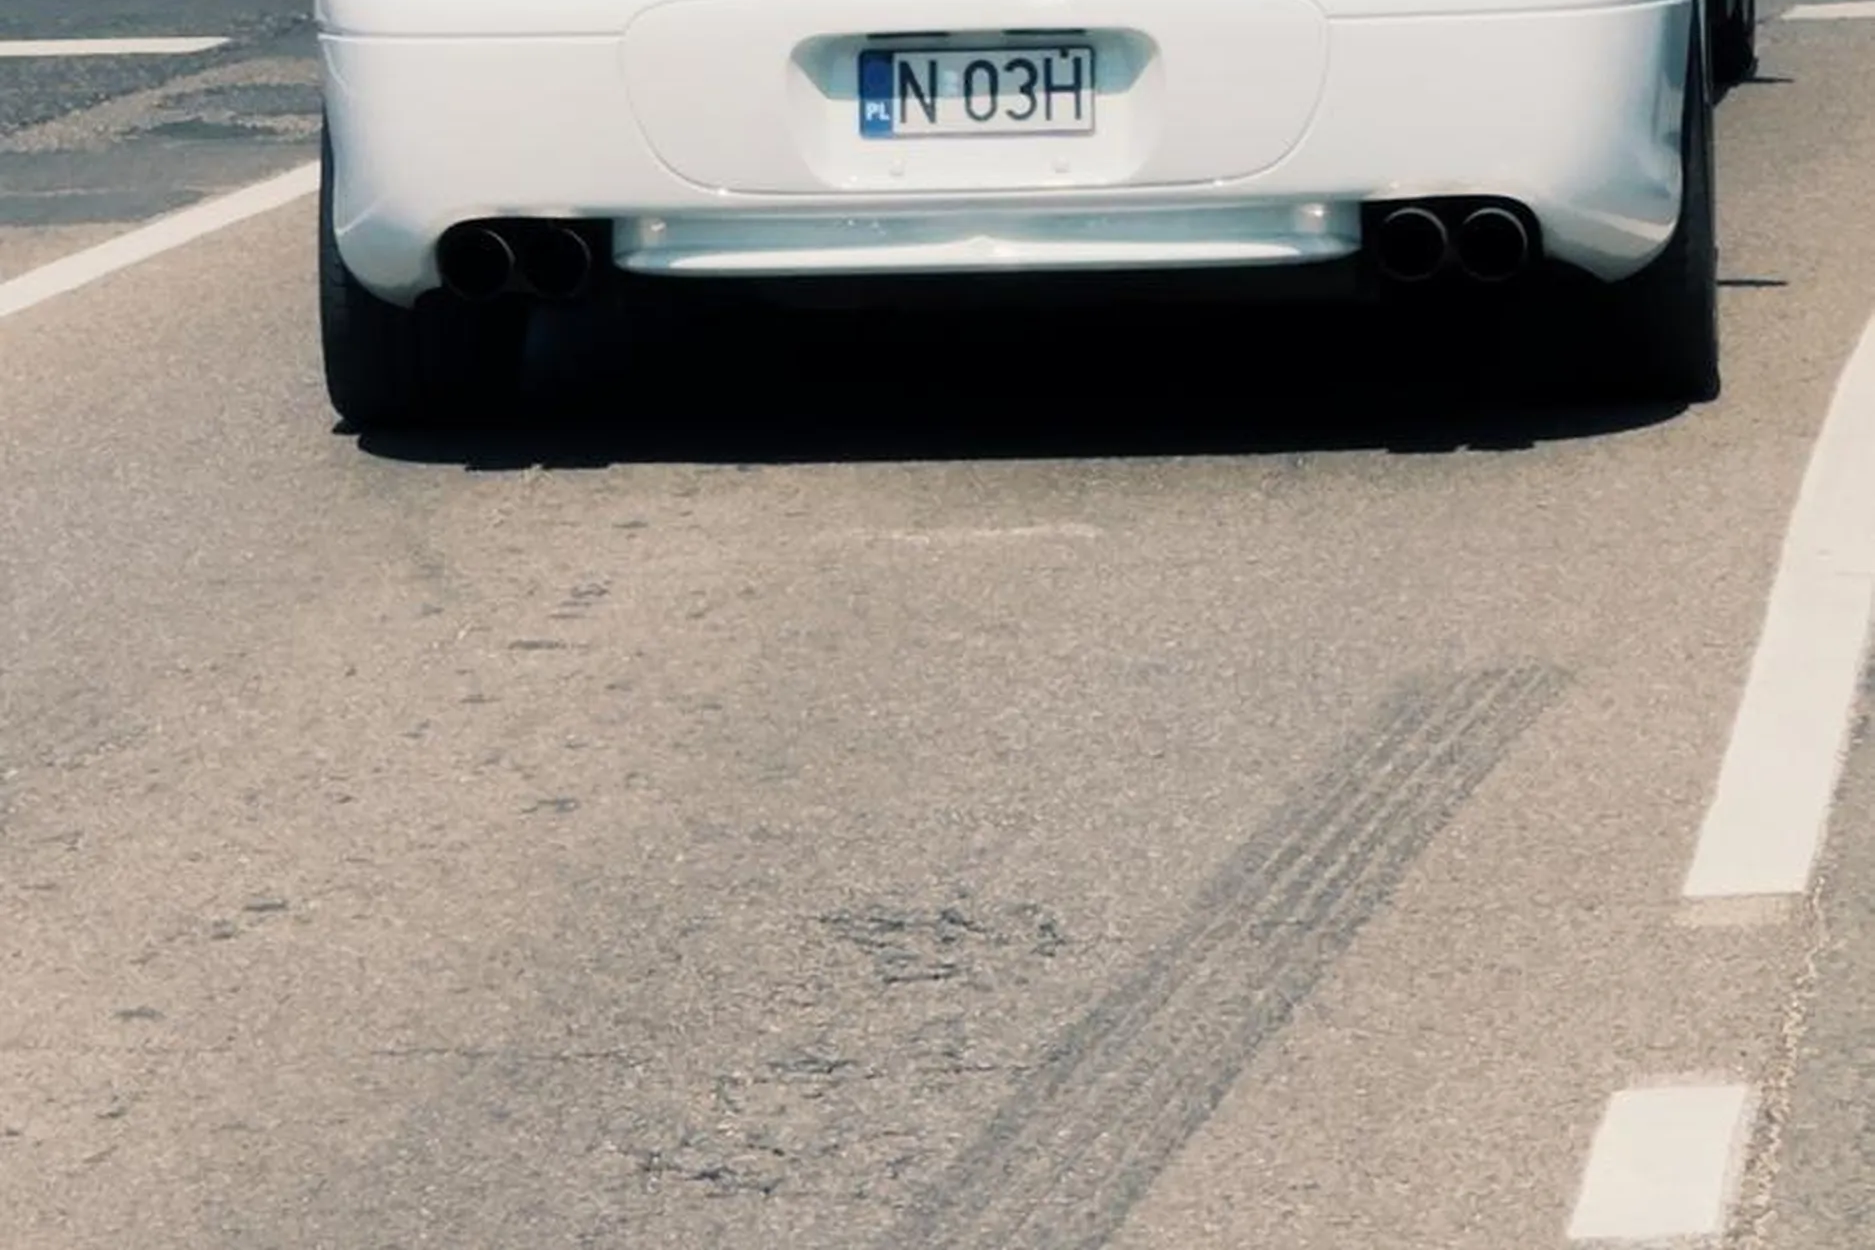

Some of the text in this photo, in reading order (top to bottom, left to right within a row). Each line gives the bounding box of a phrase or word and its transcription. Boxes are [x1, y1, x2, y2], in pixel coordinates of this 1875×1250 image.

[899, 57, 1082, 123] N 03H
[866, 103, 890, 120] PL
